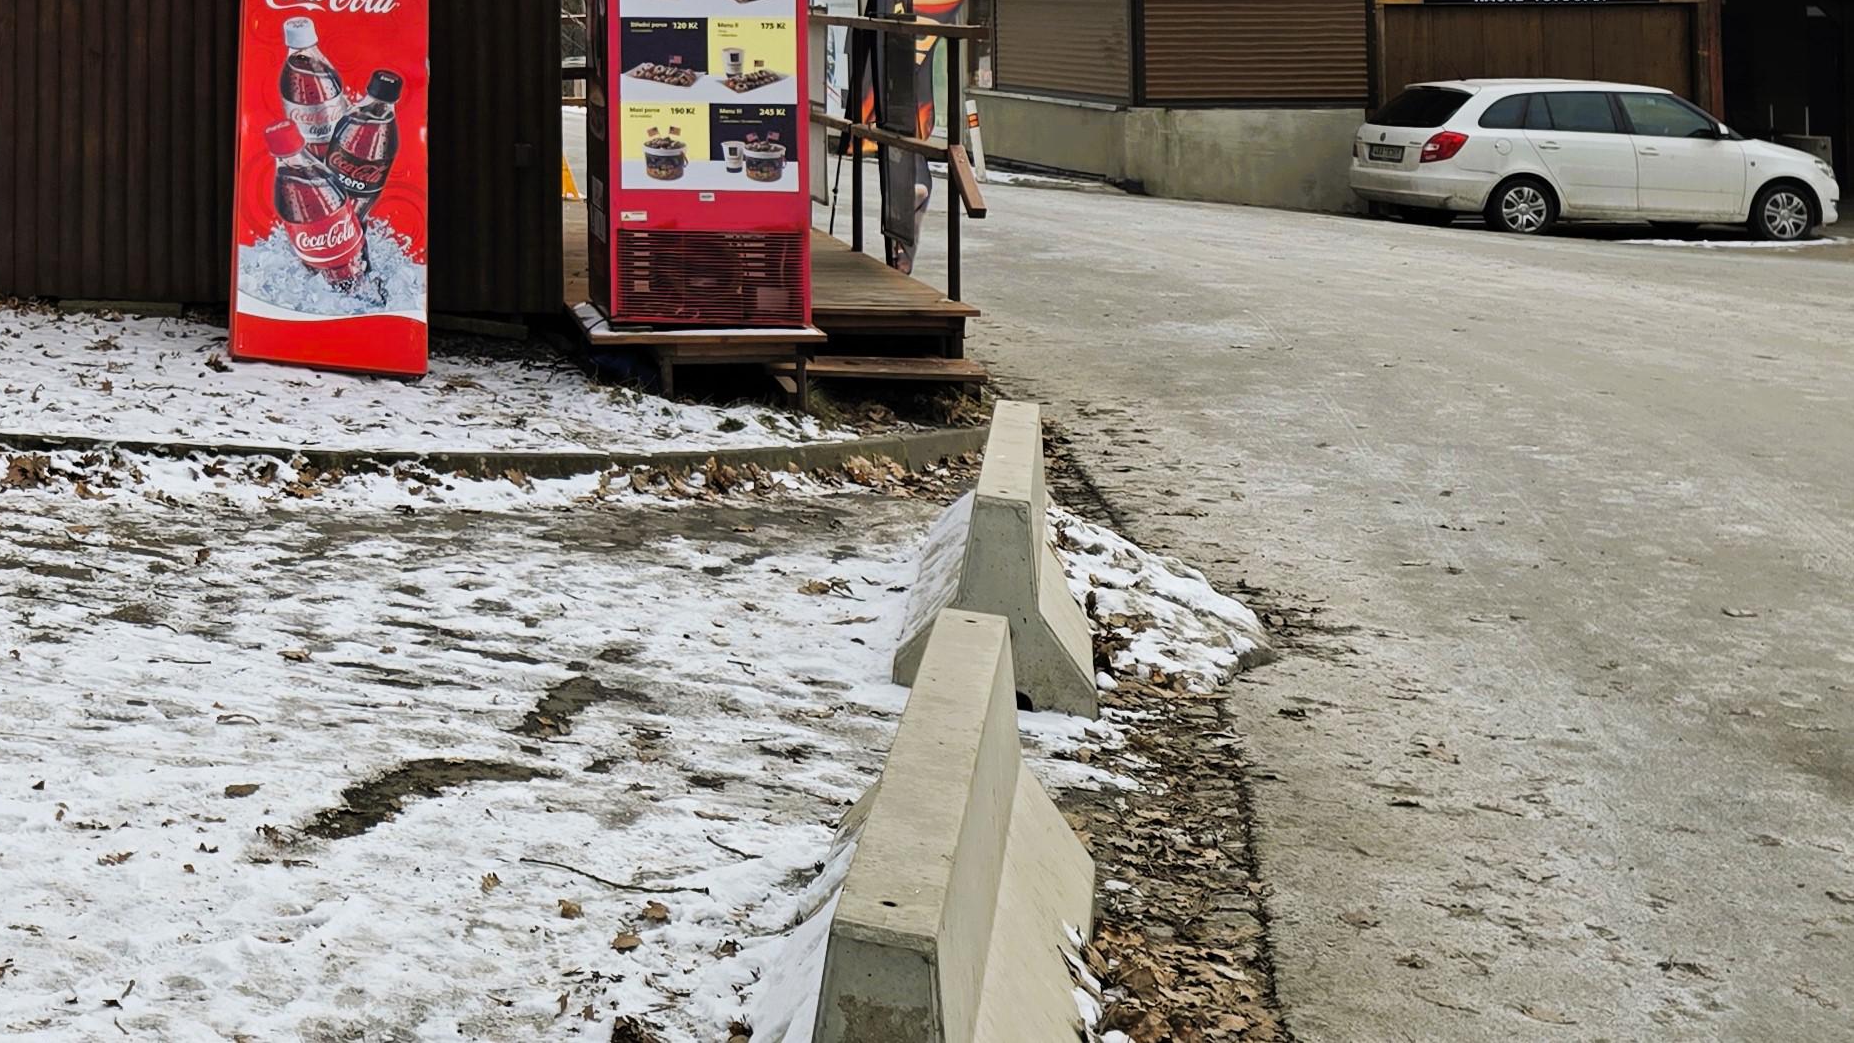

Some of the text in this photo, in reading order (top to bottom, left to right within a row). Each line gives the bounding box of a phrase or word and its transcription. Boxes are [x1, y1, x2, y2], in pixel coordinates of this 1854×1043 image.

[672, 21, 699, 30] 120 Kč
[328, 151, 389, 183] Coca-Cola
[339, 173, 366, 190] zero
[296, 214, 356, 251] Coca-Cola
